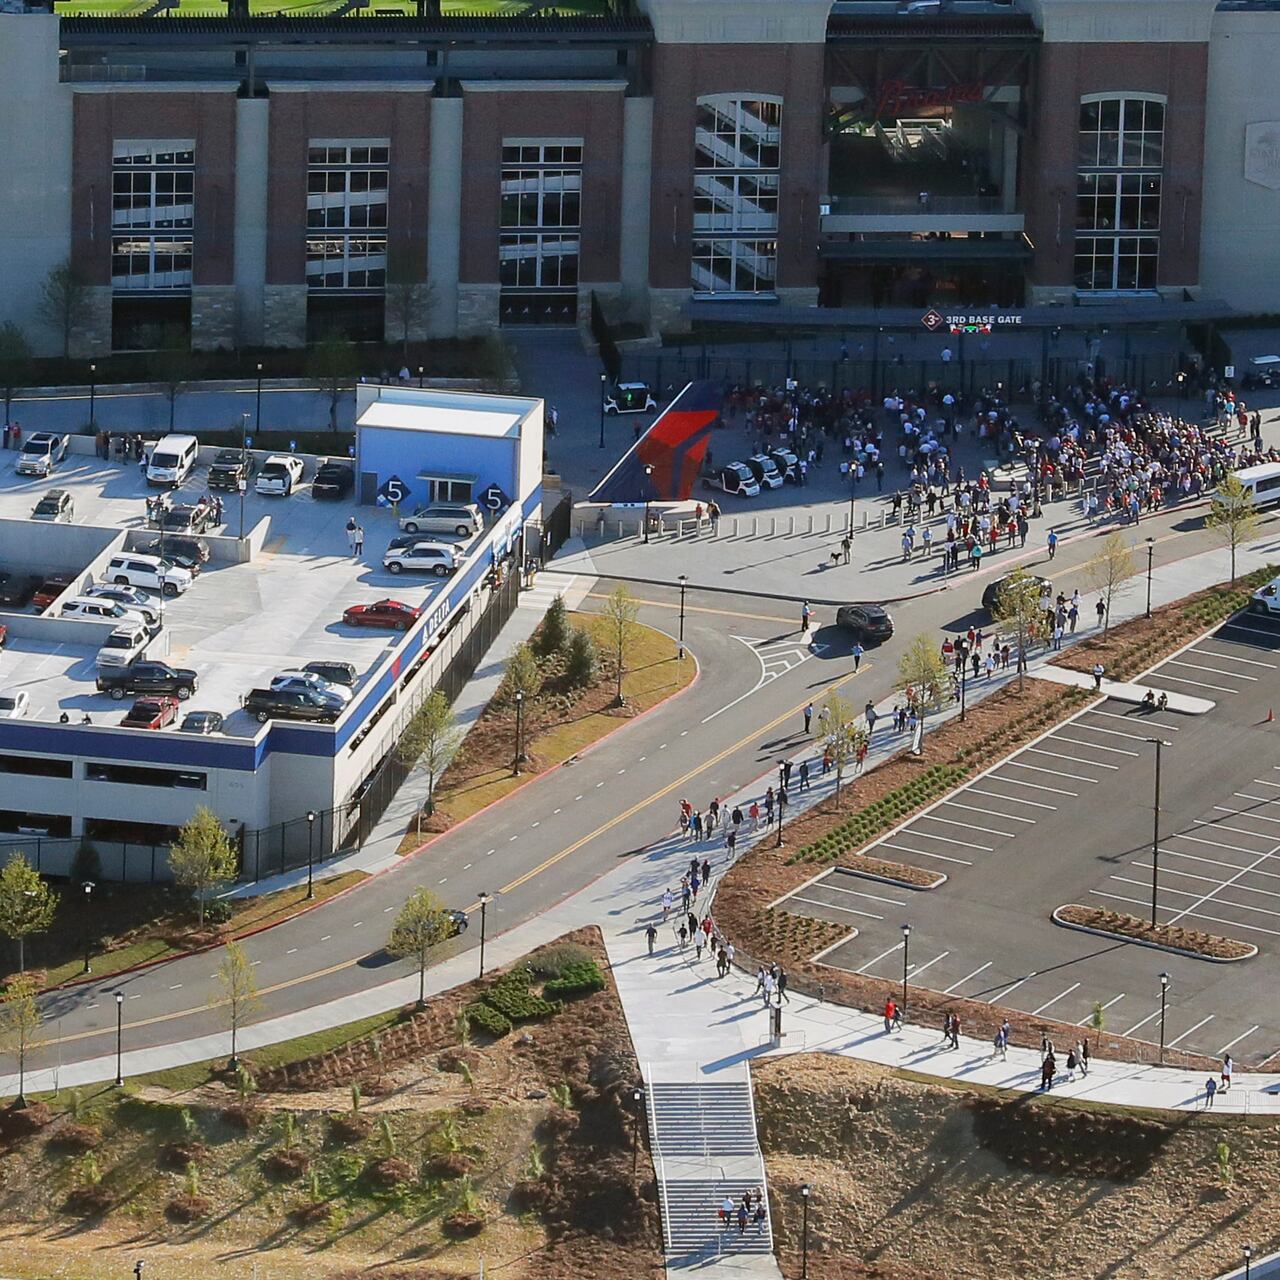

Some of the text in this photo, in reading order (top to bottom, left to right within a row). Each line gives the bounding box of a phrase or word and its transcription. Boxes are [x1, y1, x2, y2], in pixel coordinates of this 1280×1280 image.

[946, 316, 966, 324] 3RD
[969, 316, 995, 324] BASE
[998, 316, 1022, 324] GATE
[387, 481, 402, 502] 5
[486, 489, 501, 510] 5
[429, 599, 451, 635] DELTA
